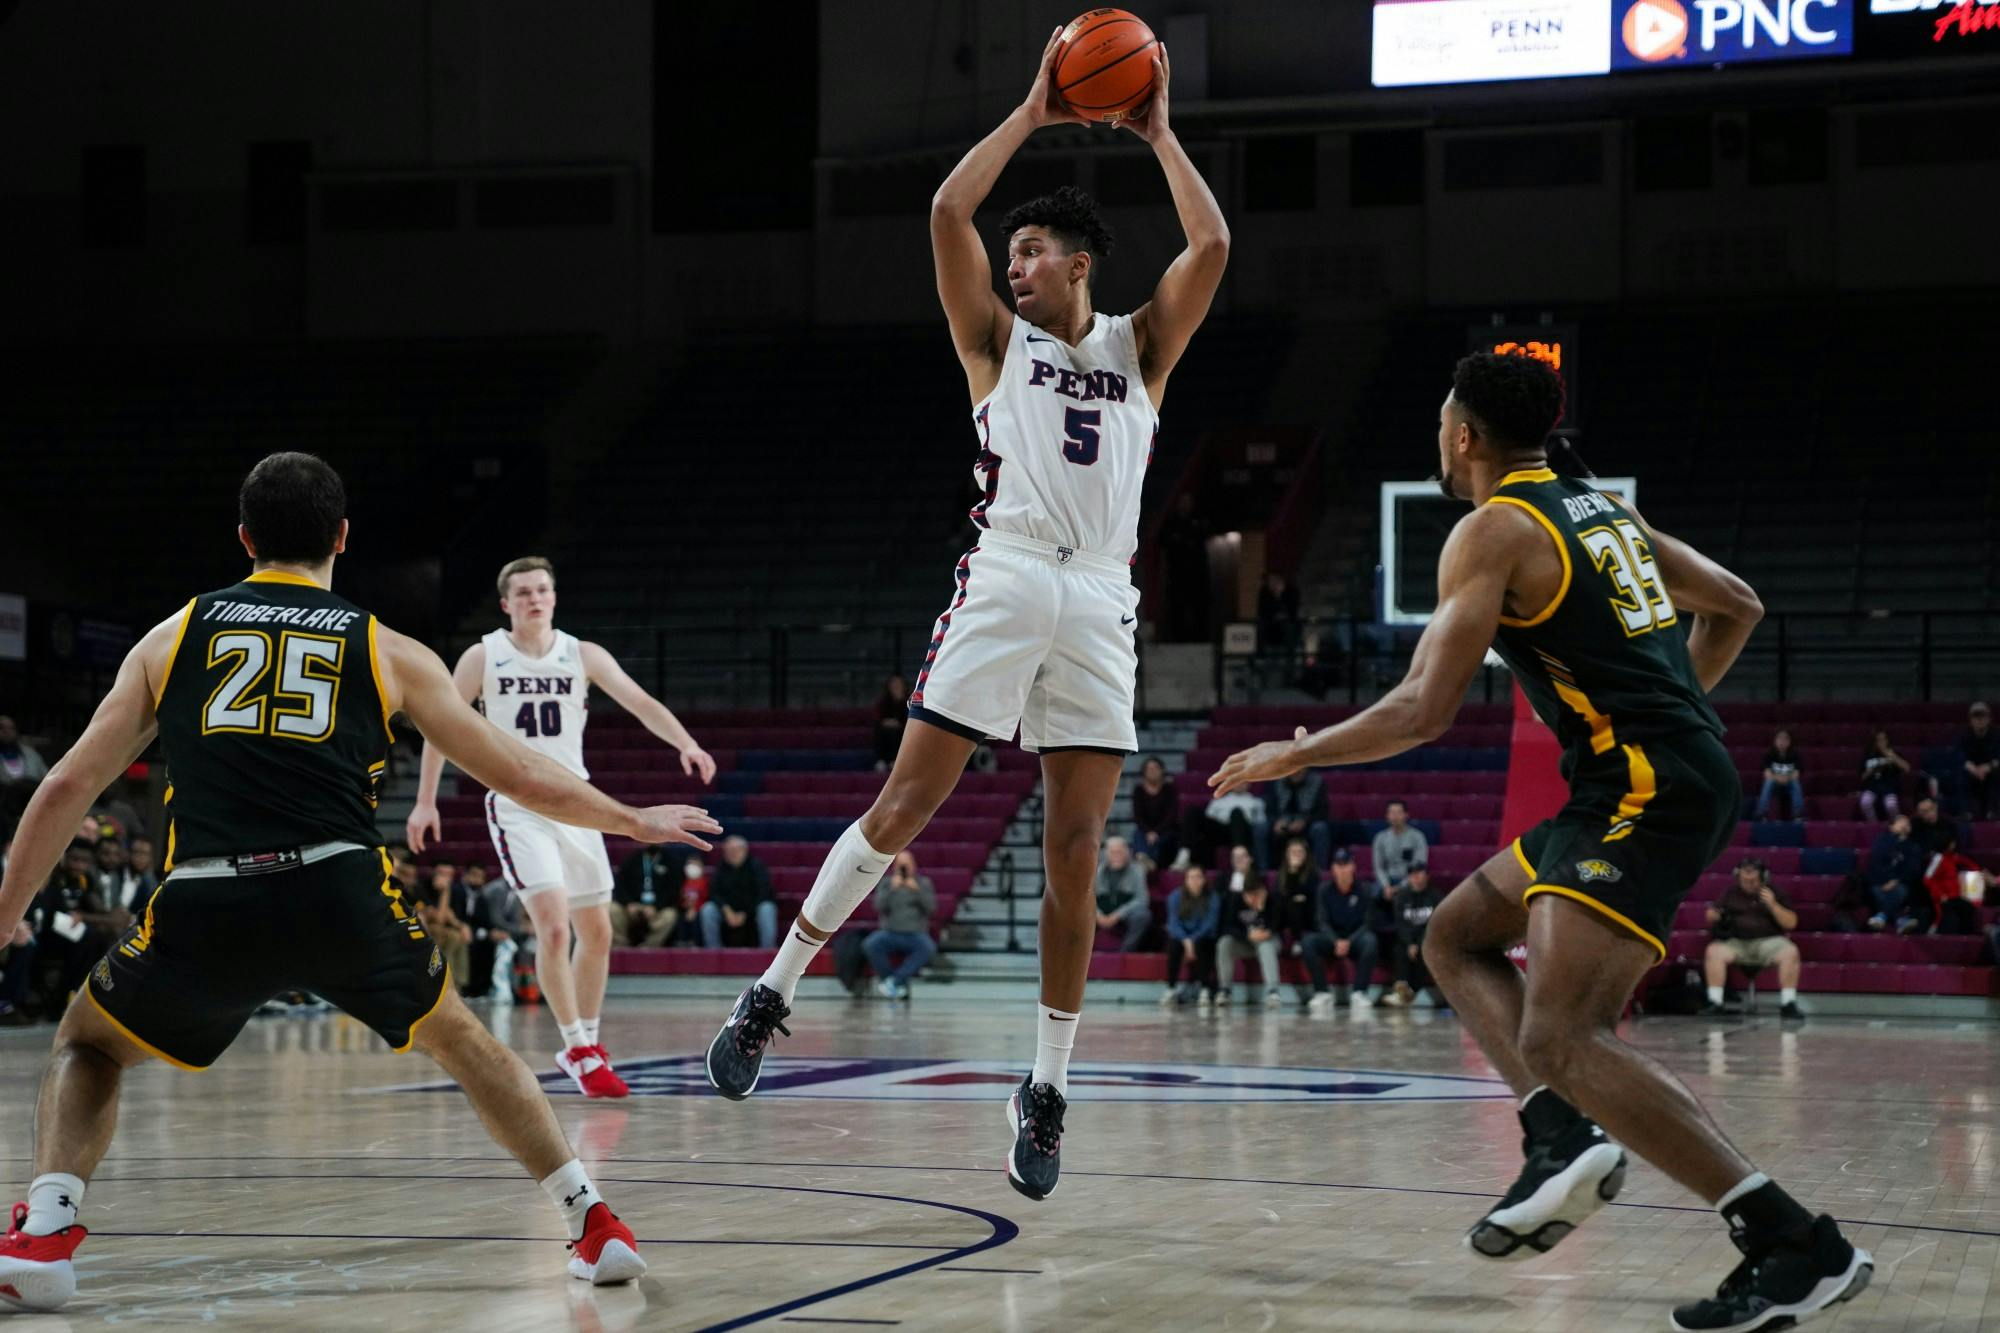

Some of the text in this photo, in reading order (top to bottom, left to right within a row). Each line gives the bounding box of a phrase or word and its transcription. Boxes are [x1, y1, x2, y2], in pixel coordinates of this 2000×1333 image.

[1490, 18, 1563, 39] PENN
[1694, 0, 1838, 51] PNC
[1028, 358, 1128, 404] PENN
[1062, 405, 1102, 467] 5
[1577, 519, 1677, 638] 35
[203, 600, 360, 632] TIMBERLAKE
[202, 629, 346, 743] 25
[497, 676, 573, 695] PENN
[515, 700, 562, 738] 40
